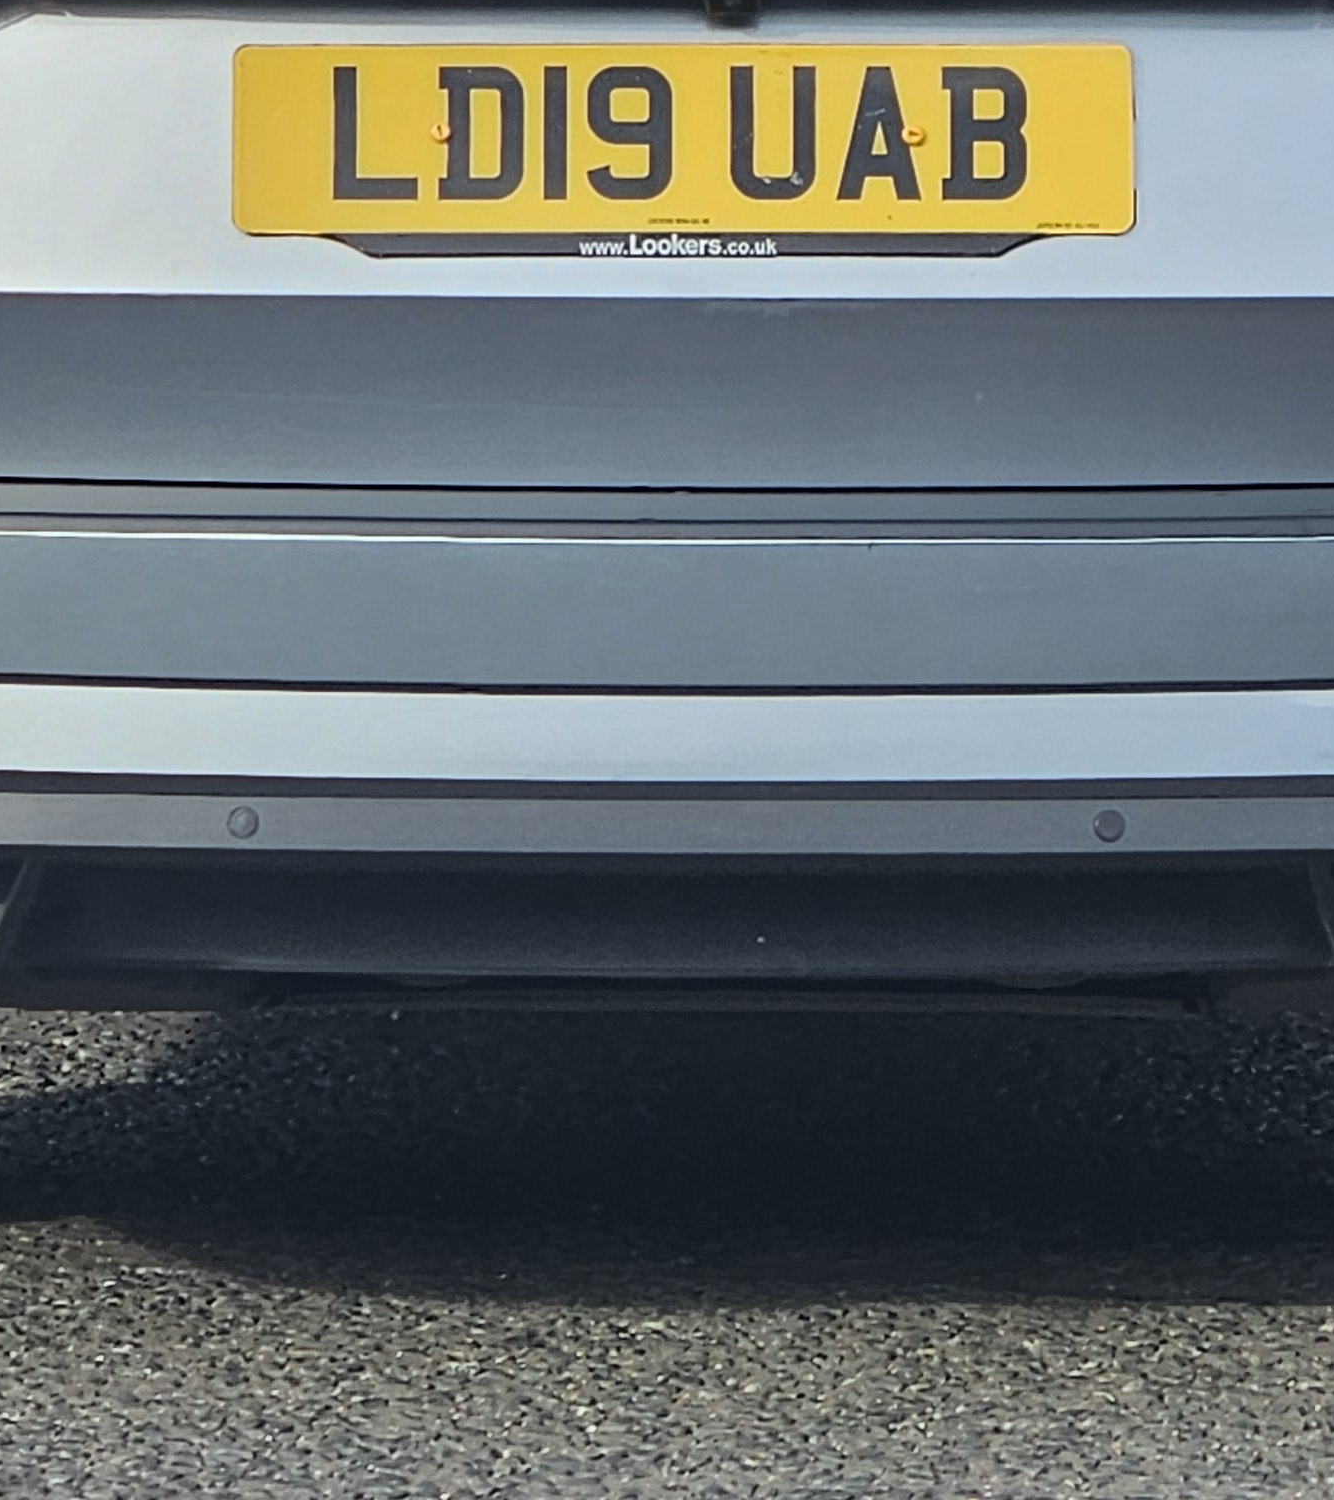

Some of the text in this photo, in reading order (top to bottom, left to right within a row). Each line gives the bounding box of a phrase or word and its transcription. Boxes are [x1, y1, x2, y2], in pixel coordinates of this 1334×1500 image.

[333, 65, 1029, 201] LD19 UAB
[578, 233, 778, 257] www.Lookers.co.uk
